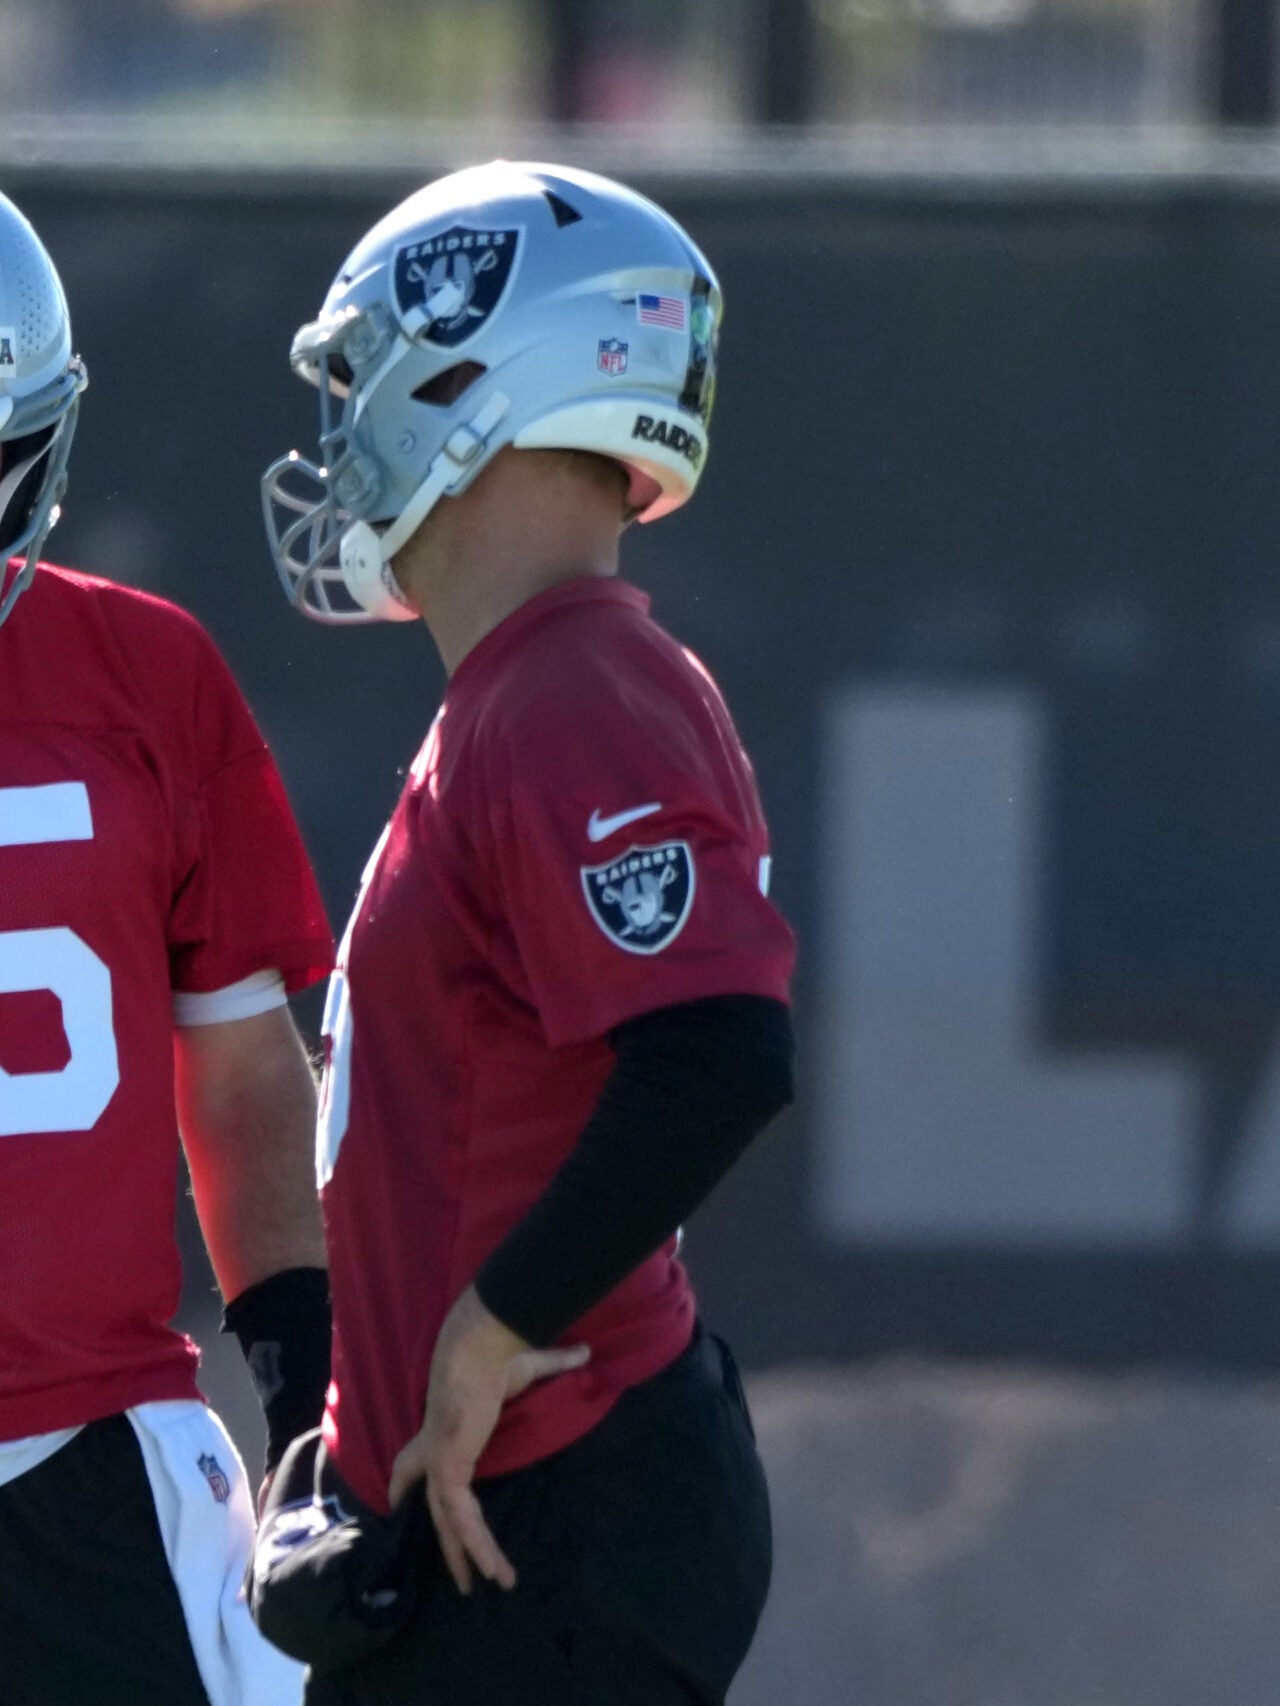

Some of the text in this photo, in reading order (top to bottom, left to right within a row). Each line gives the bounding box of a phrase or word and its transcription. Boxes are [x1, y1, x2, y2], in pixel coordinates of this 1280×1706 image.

[405, 232, 506, 260] RAIDERS
[600, 351, 626, 373] NFL
[595, 847, 679, 887] RAIDERS
